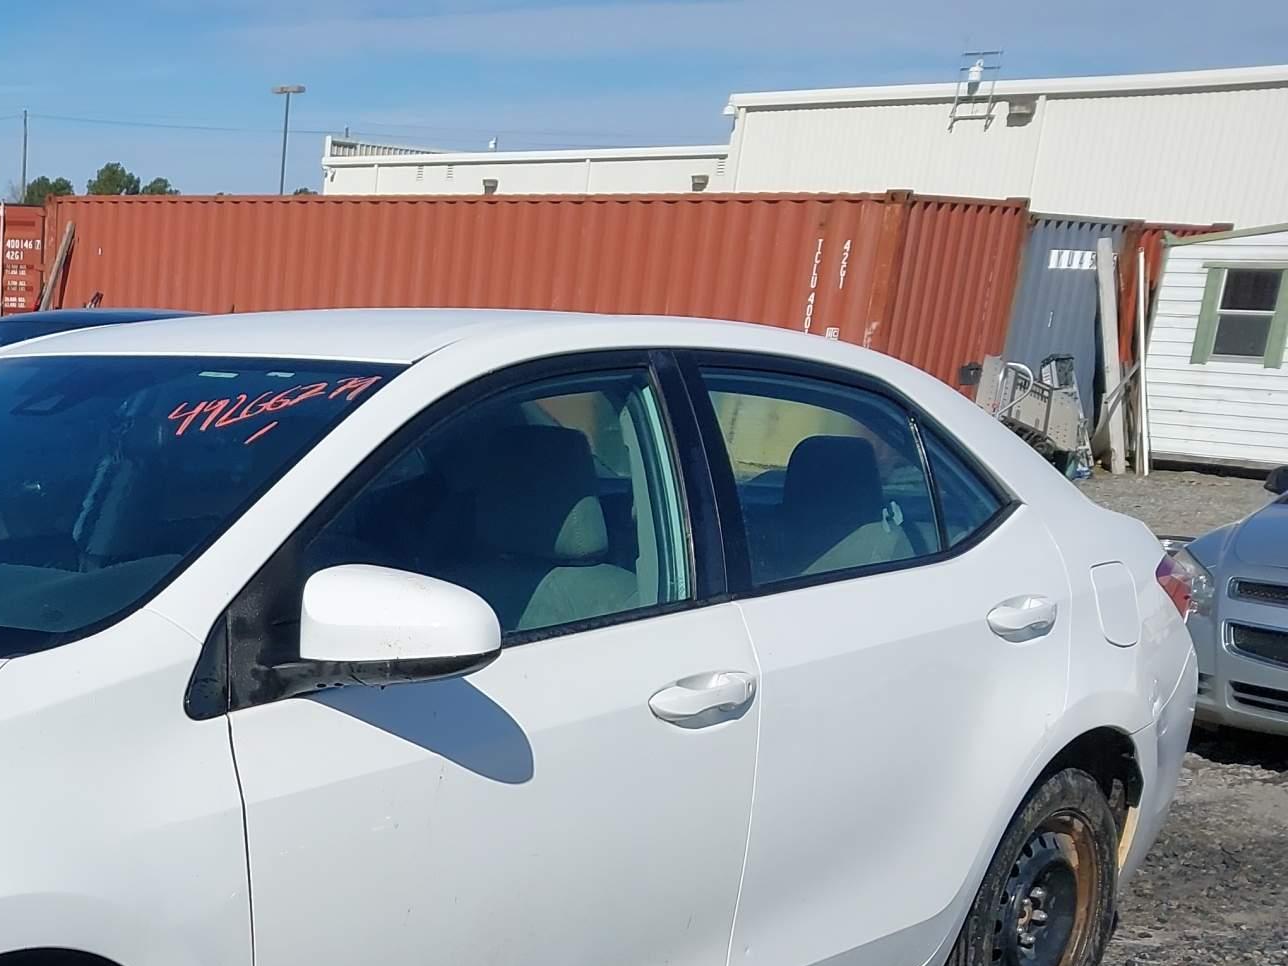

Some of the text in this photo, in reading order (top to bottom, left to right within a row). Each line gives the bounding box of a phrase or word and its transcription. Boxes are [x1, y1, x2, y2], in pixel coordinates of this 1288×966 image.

[5, 250, 24, 260] 42G1
[810, 238, 824, 289] TCLU
[839, 239, 852, 290] 42G1
